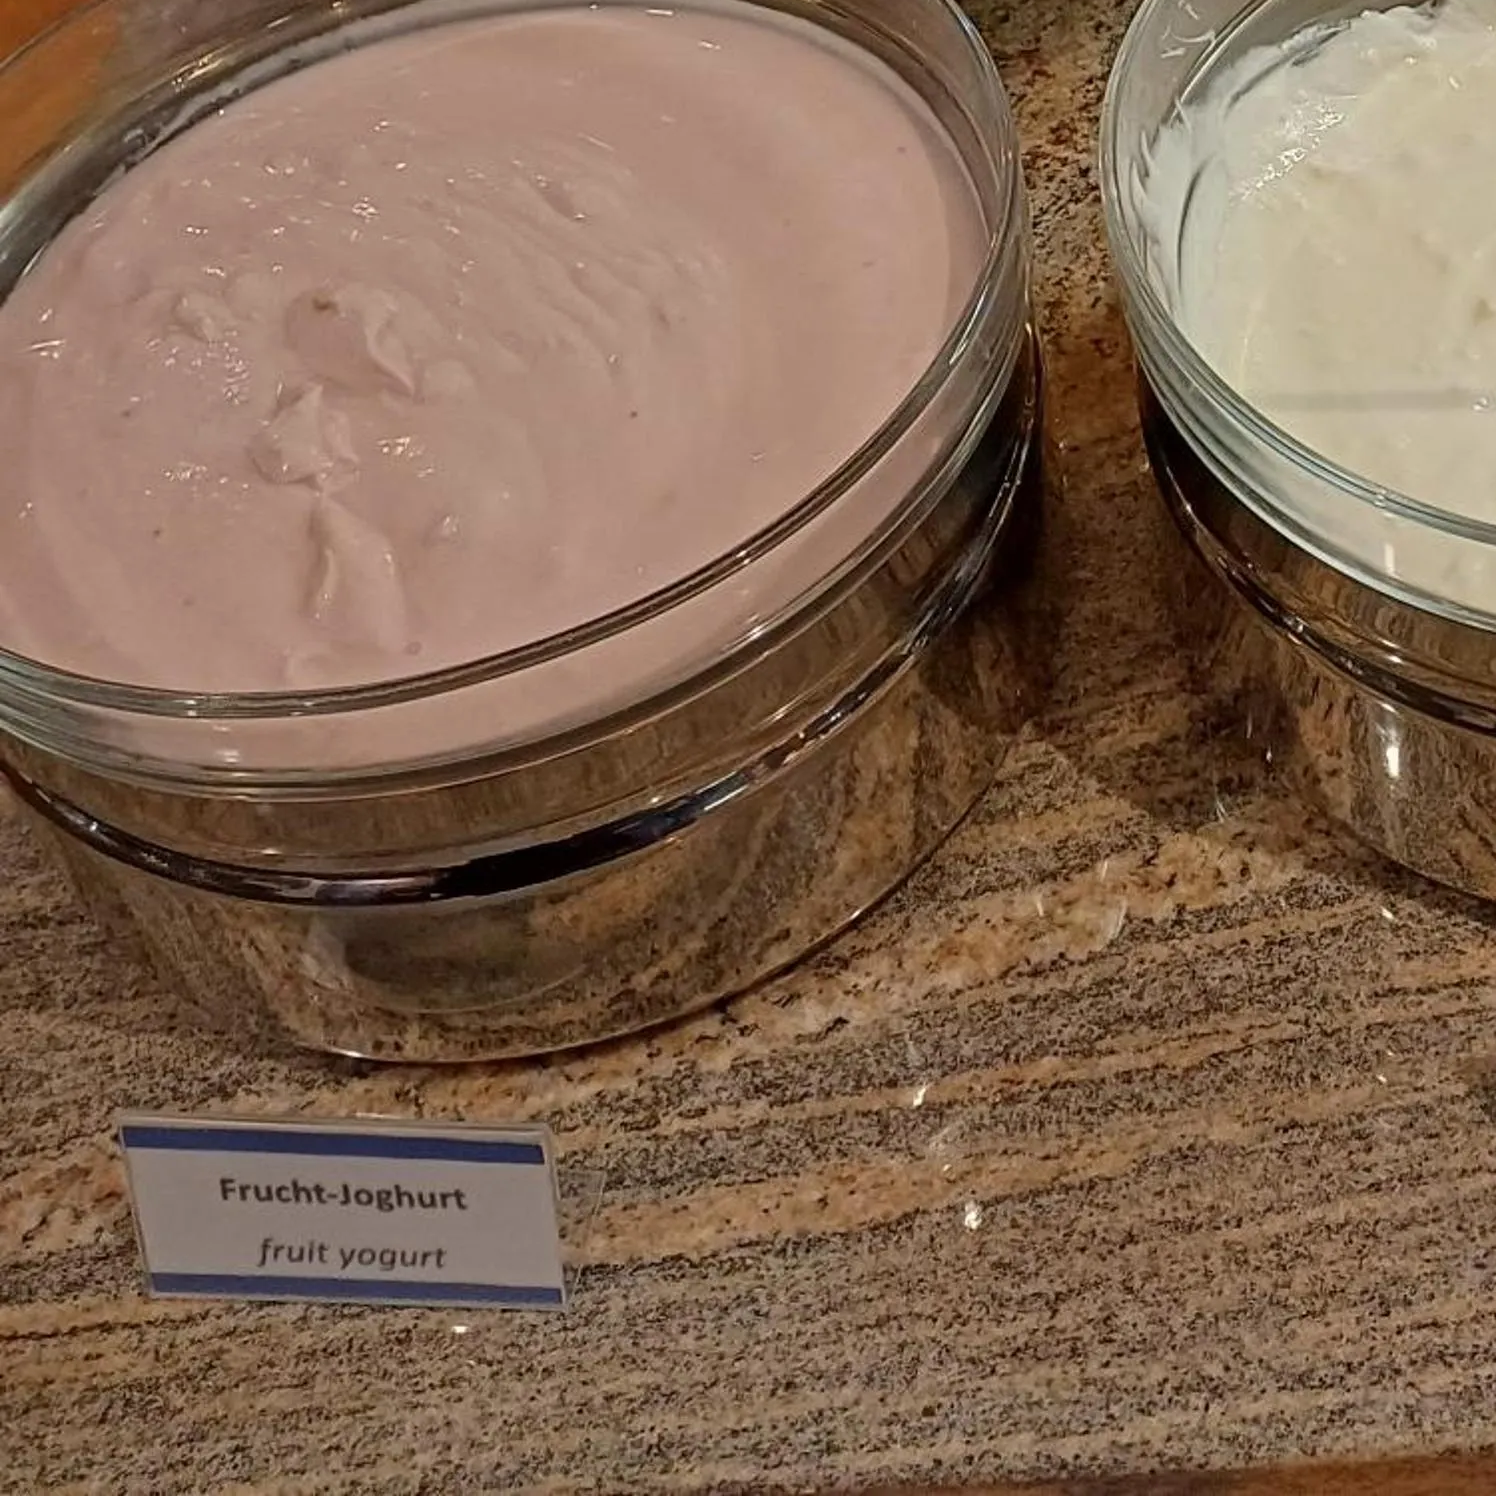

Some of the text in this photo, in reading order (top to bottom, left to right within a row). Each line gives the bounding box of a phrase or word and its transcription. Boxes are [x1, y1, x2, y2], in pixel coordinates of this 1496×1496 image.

[219, 1177, 468, 1213] Frucht-Joghurt
[256, 1237, 448, 1272] fruit yogurt
